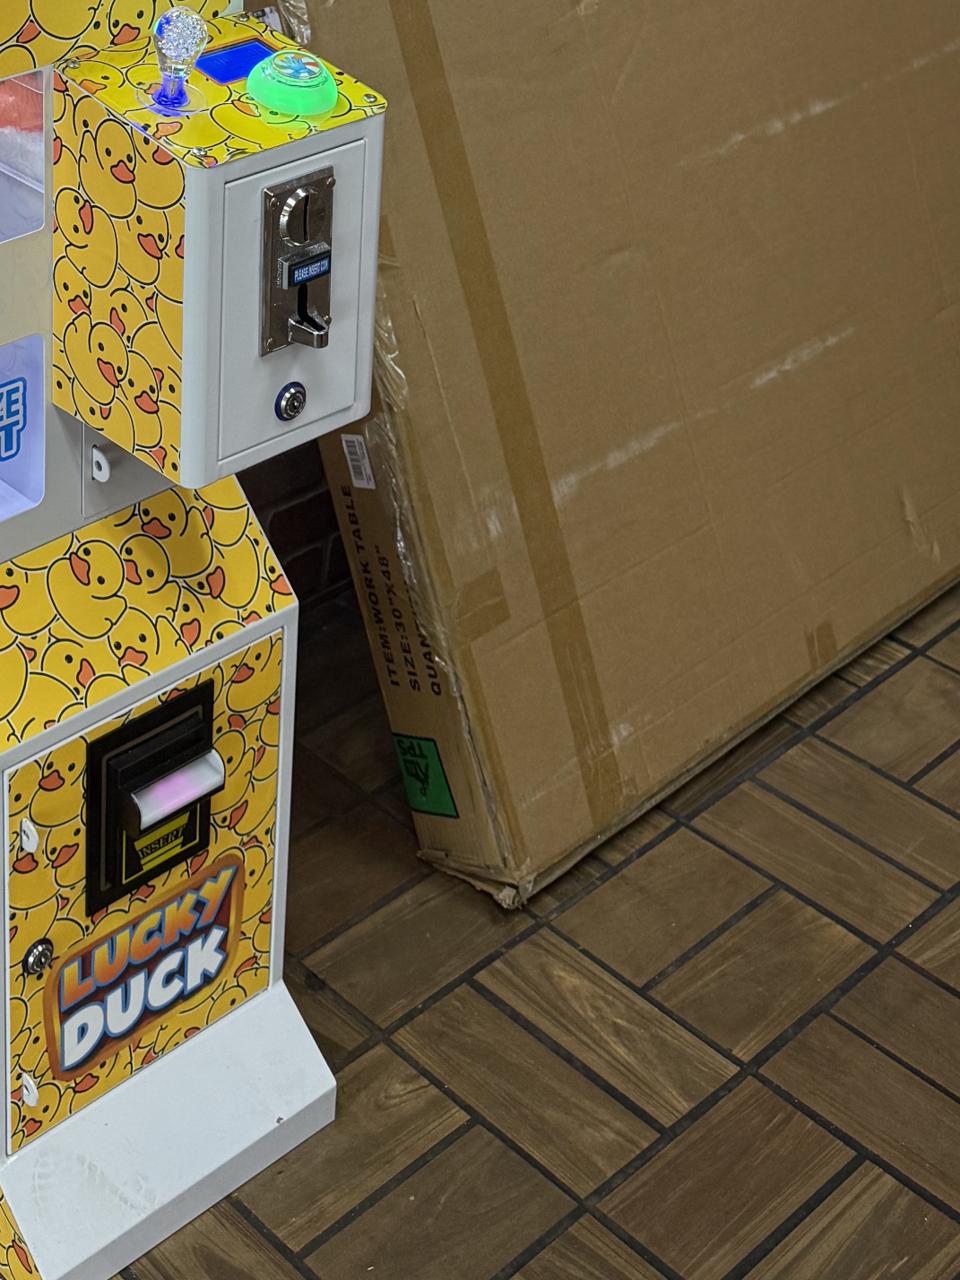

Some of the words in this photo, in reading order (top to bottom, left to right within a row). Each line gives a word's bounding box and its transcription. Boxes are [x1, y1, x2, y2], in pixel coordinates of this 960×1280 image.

[341, 484, 365, 555] TABLE
[138, 828, 183, 859] INSERT
[60, 866, 237, 1012] LUCKY
[61, 925, 228, 1072] DUCK
